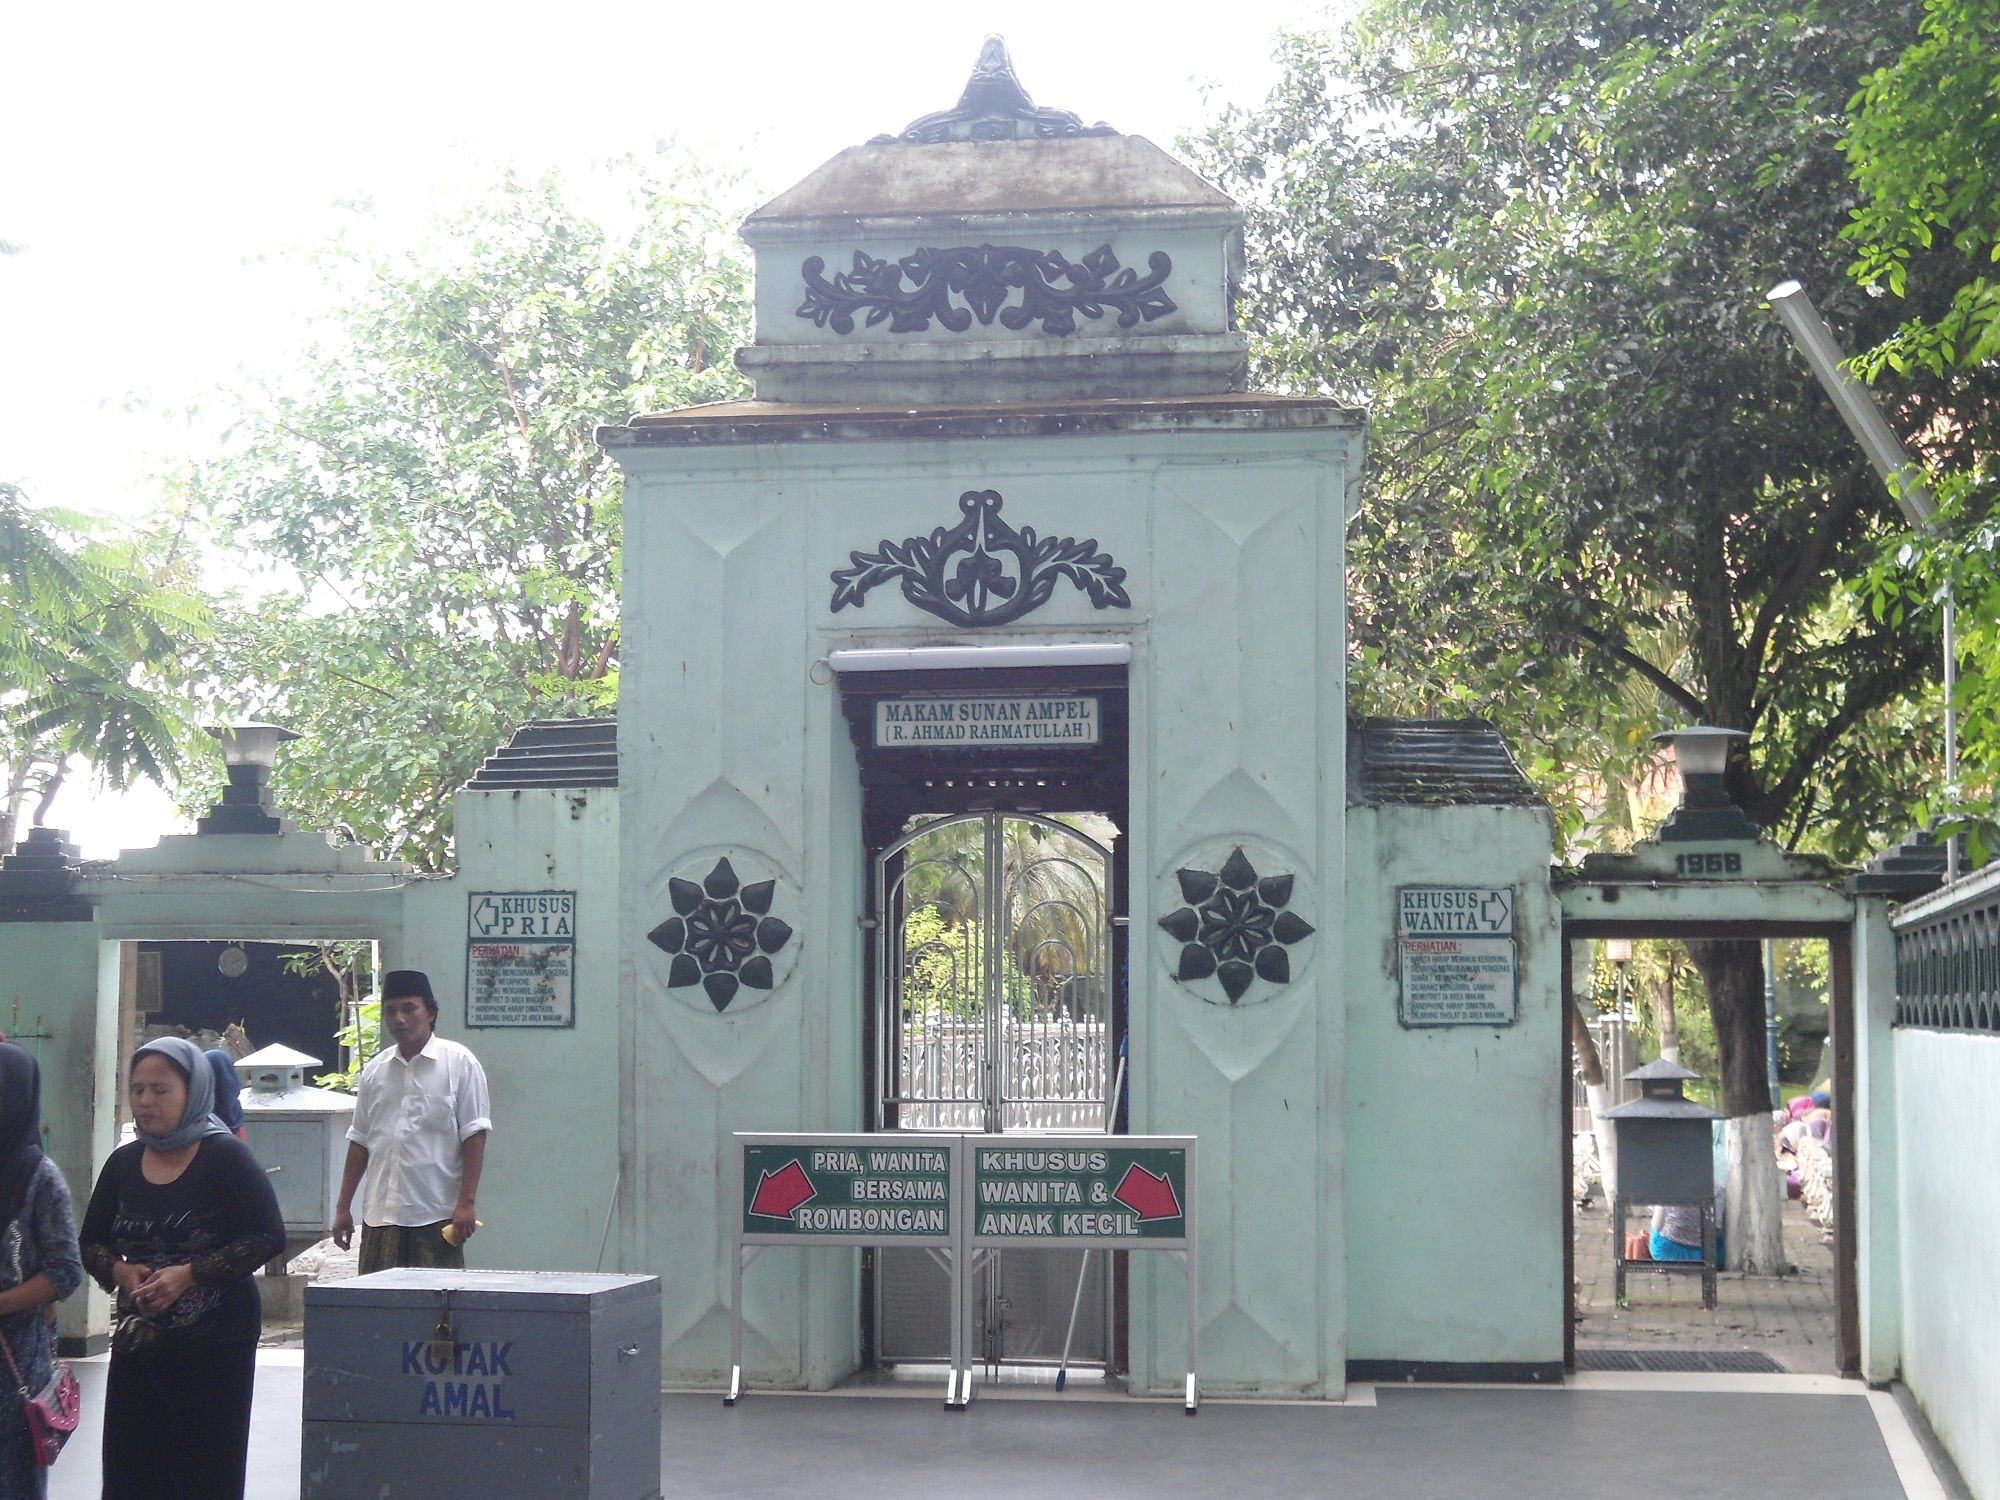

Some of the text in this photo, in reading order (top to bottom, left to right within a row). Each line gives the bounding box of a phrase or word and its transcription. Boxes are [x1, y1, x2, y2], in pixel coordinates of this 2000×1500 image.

[886, 701, 1090, 722] MAKAM SUNAN AMPEL
[912, 725, 966, 740] AHMAD
[969, 722, 1083, 739] RAHMATULLAH
[501, 897, 571, 914] KHUSUS
[1403, 892, 1478, 909] KHUSUS
[502, 916, 571, 935] PRIA
[1404, 911, 1478, 931] WANITA
[813, 1152, 946, 1175] PRIA, WANITA
[981, 1152, 1107, 1171] KHUSUS
[853, 1180, 946, 1200] BERSAMA
[981, 1180, 1109, 1204] WANITA &
[799, 1208, 944, 1231] ROMBONGAN
[981, 1213, 1140, 1236] ANAK KECIL
[420, 1382, 514, 1418] AMAL
